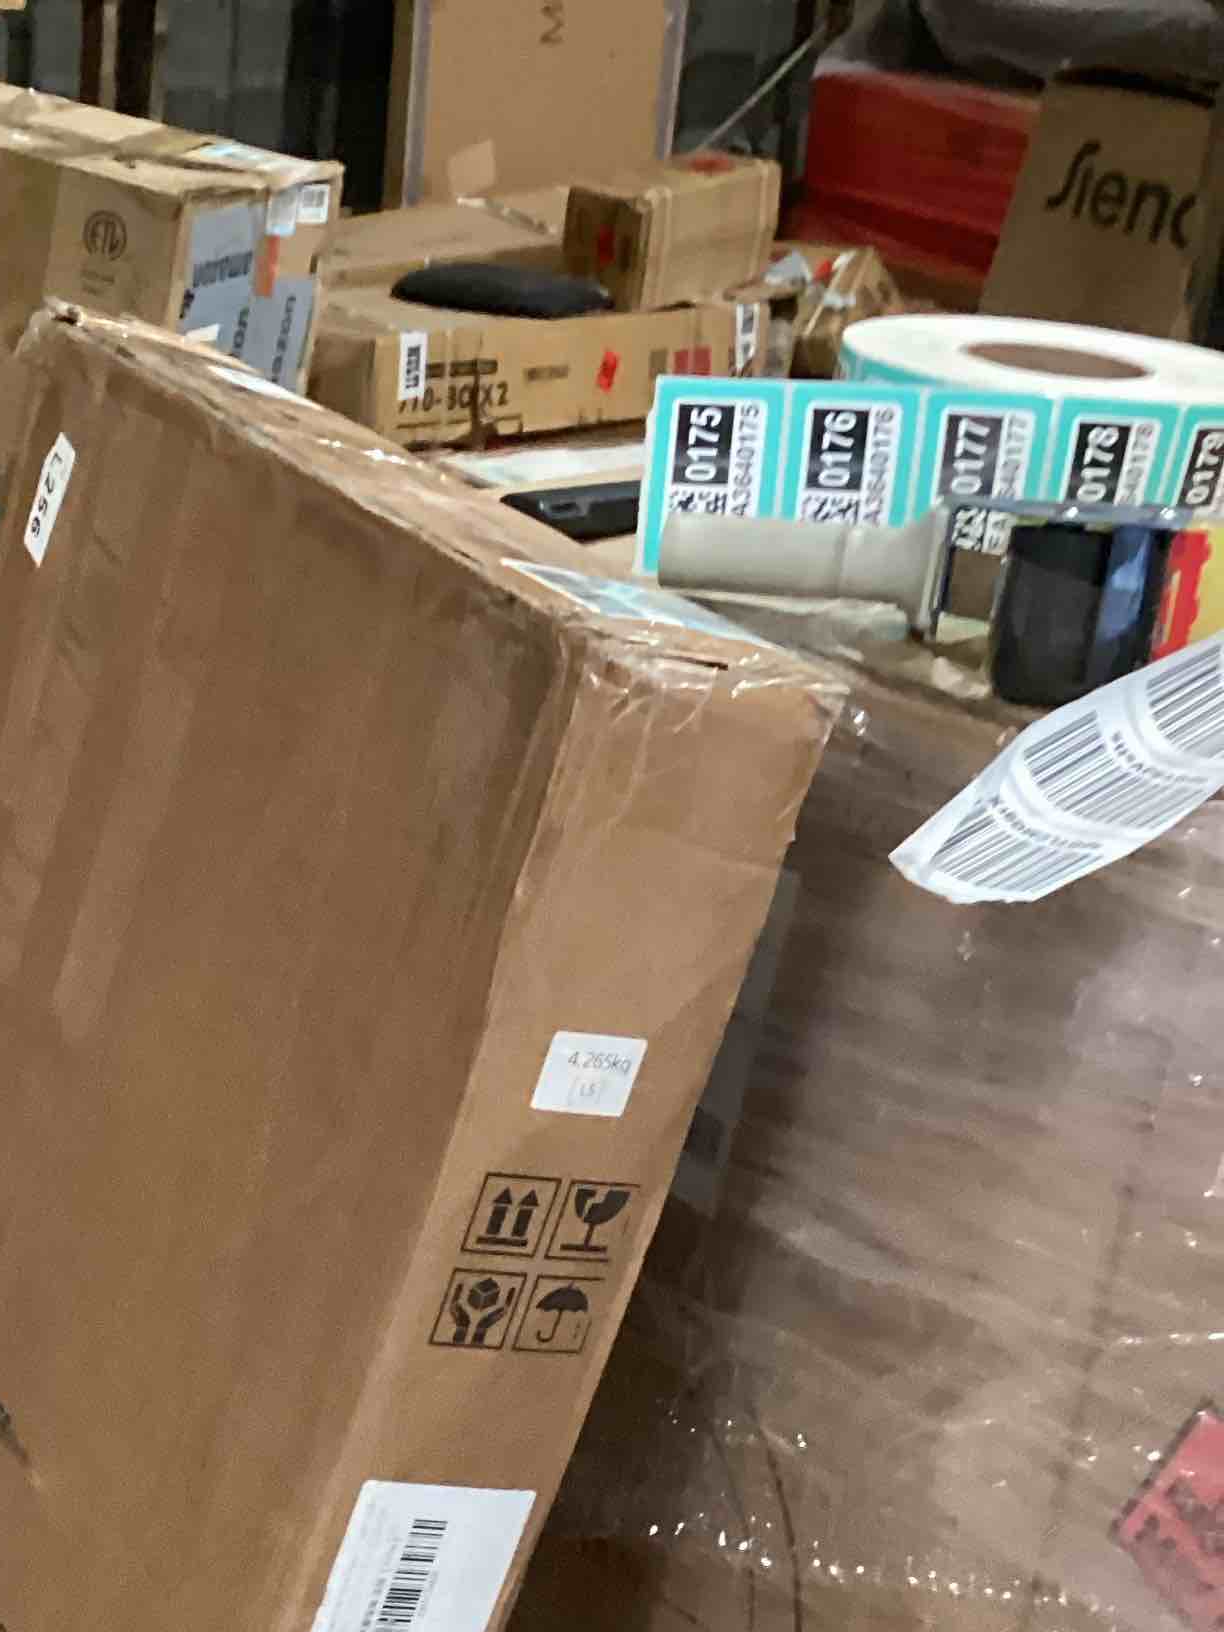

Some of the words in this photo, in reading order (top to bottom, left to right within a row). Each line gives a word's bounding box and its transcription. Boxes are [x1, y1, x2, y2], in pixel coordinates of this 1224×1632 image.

[684, 406, 723, 482] 0175
[817, 410, 857, 487] 0176
[950, 416, 990, 495] 0177
[1076, 426, 1120, 503] 0178
